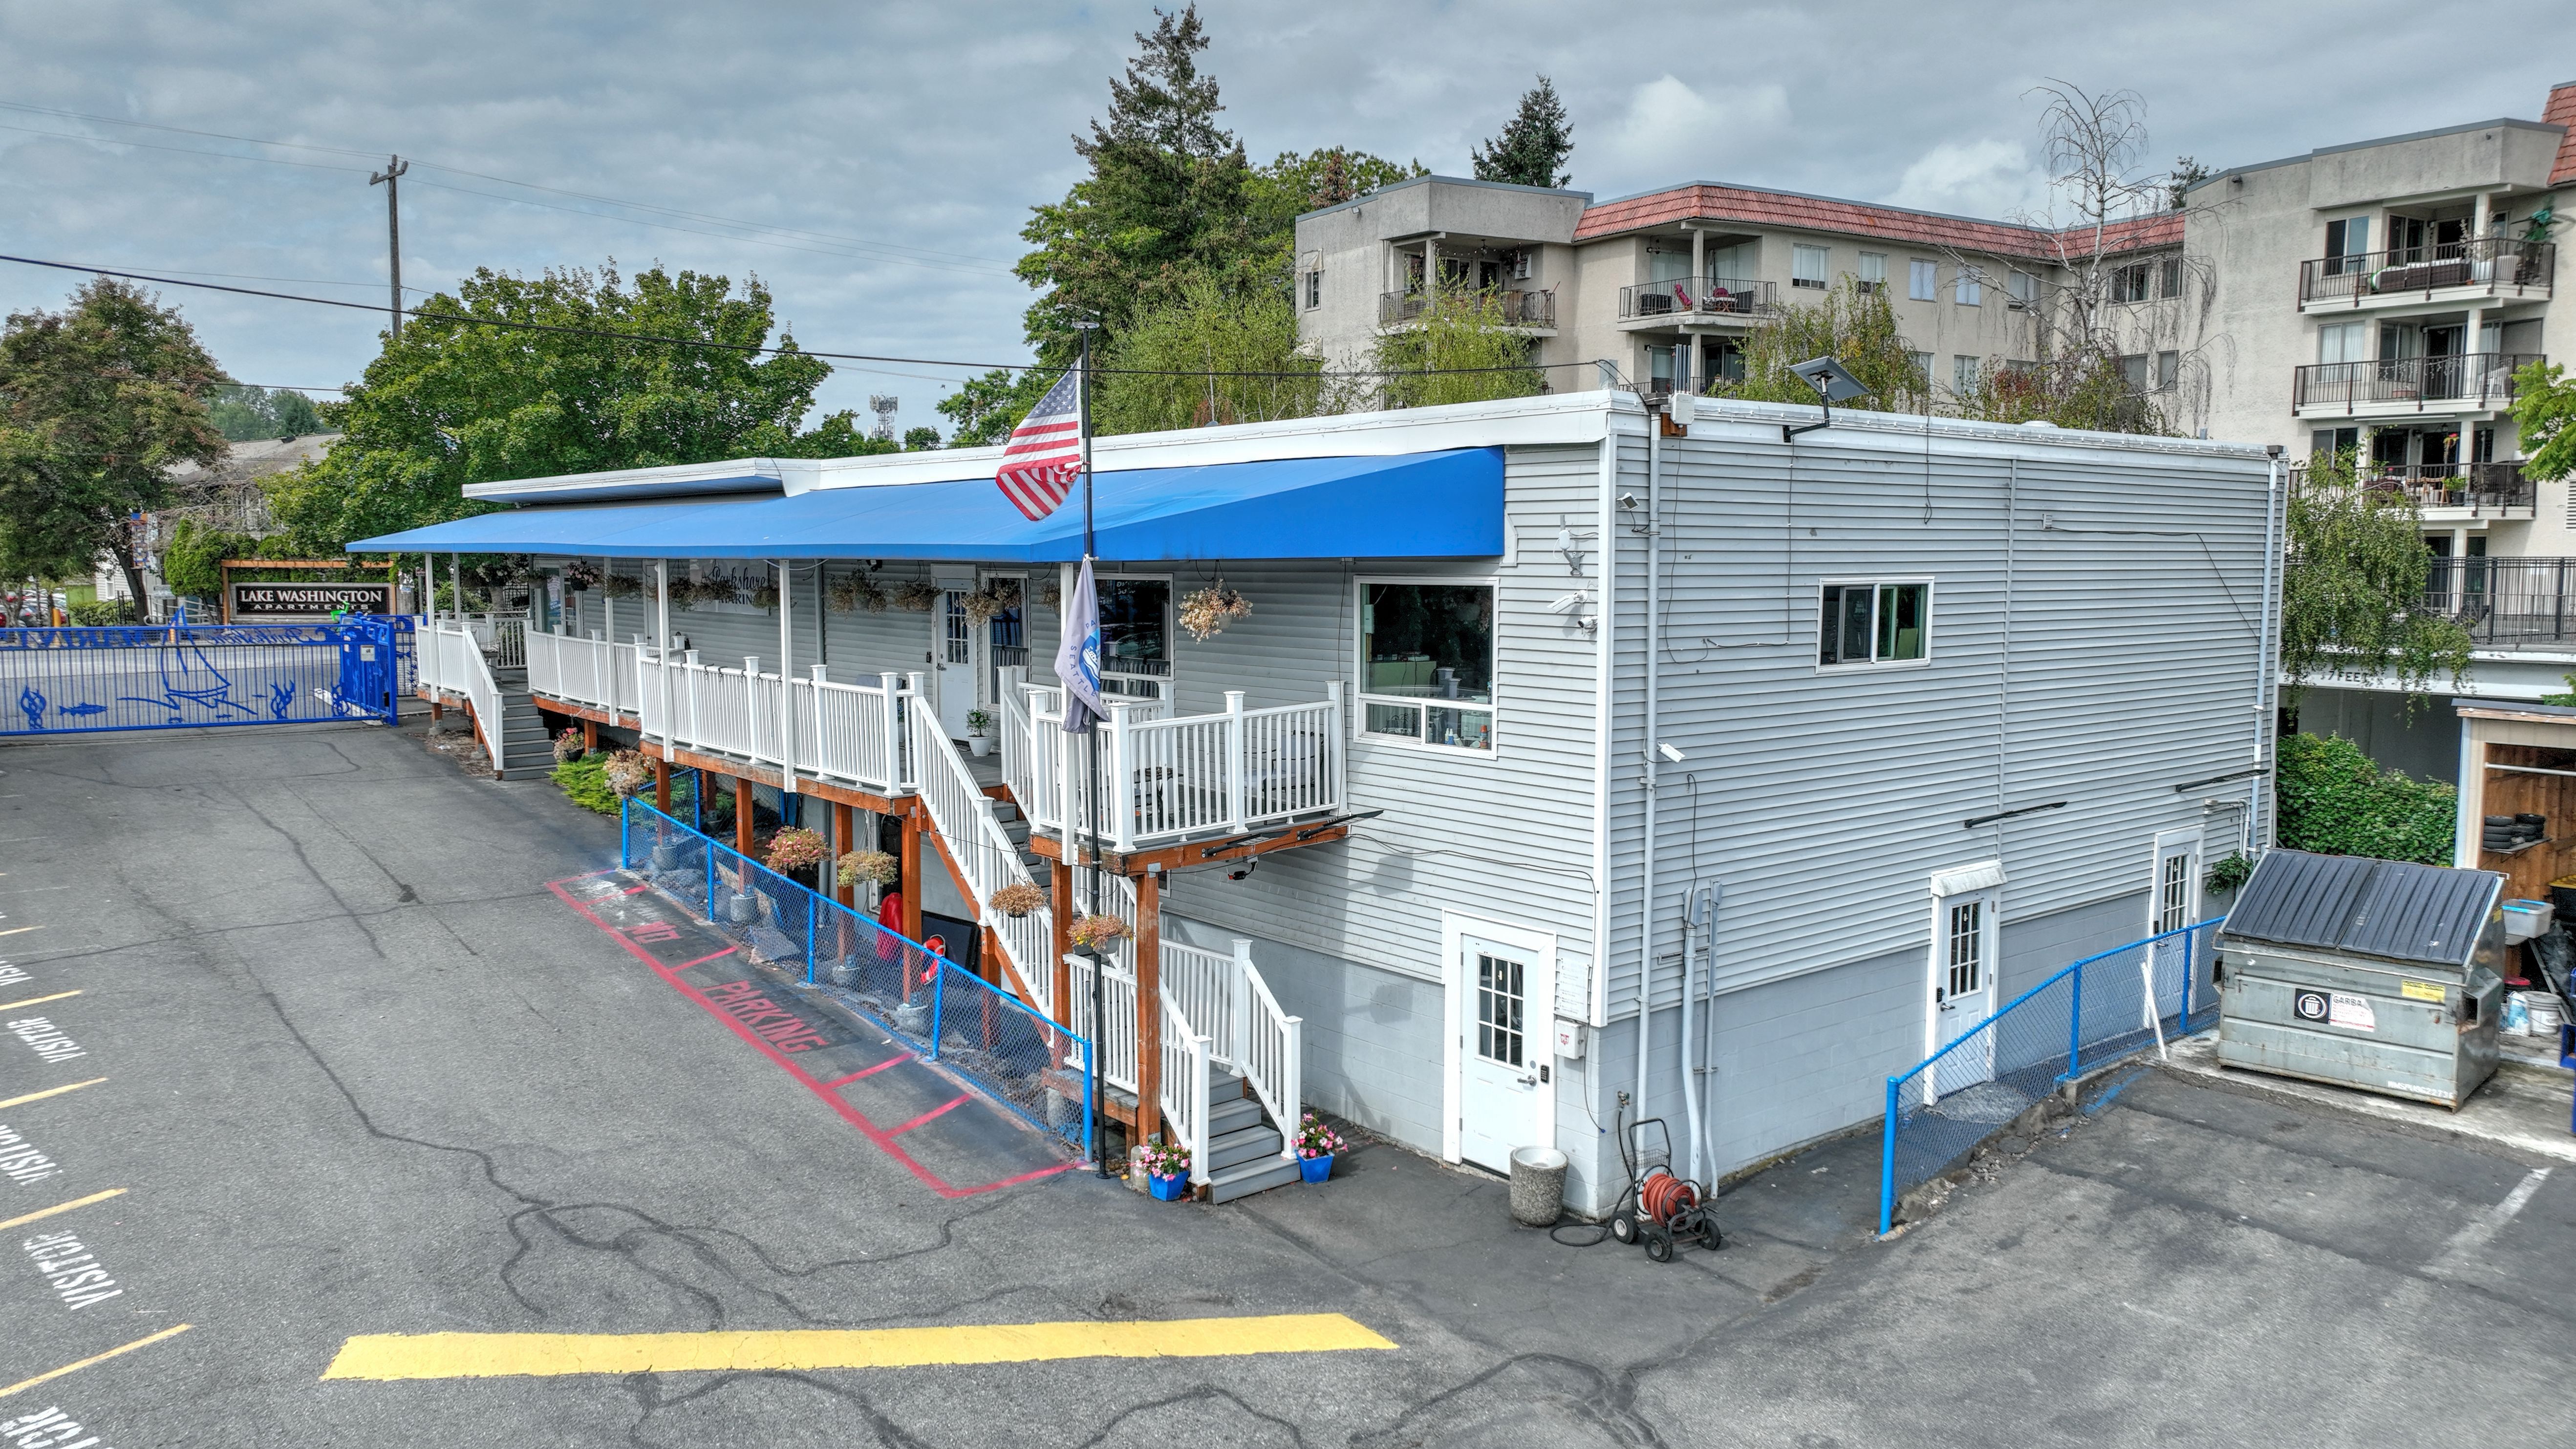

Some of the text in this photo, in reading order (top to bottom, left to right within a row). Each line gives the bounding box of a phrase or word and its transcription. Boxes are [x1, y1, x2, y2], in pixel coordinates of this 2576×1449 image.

[240, 590, 383, 602] LAKE WASHINGTON
[712, 566, 766, 590] Parkshore
[1069, 645, 1096, 697] SEATTLE
[622, 920, 829, 1053] NO PARKING
[7, 1017, 87, 1064] VISITOR
[23, 1229, 123, 1310] VISITOR
